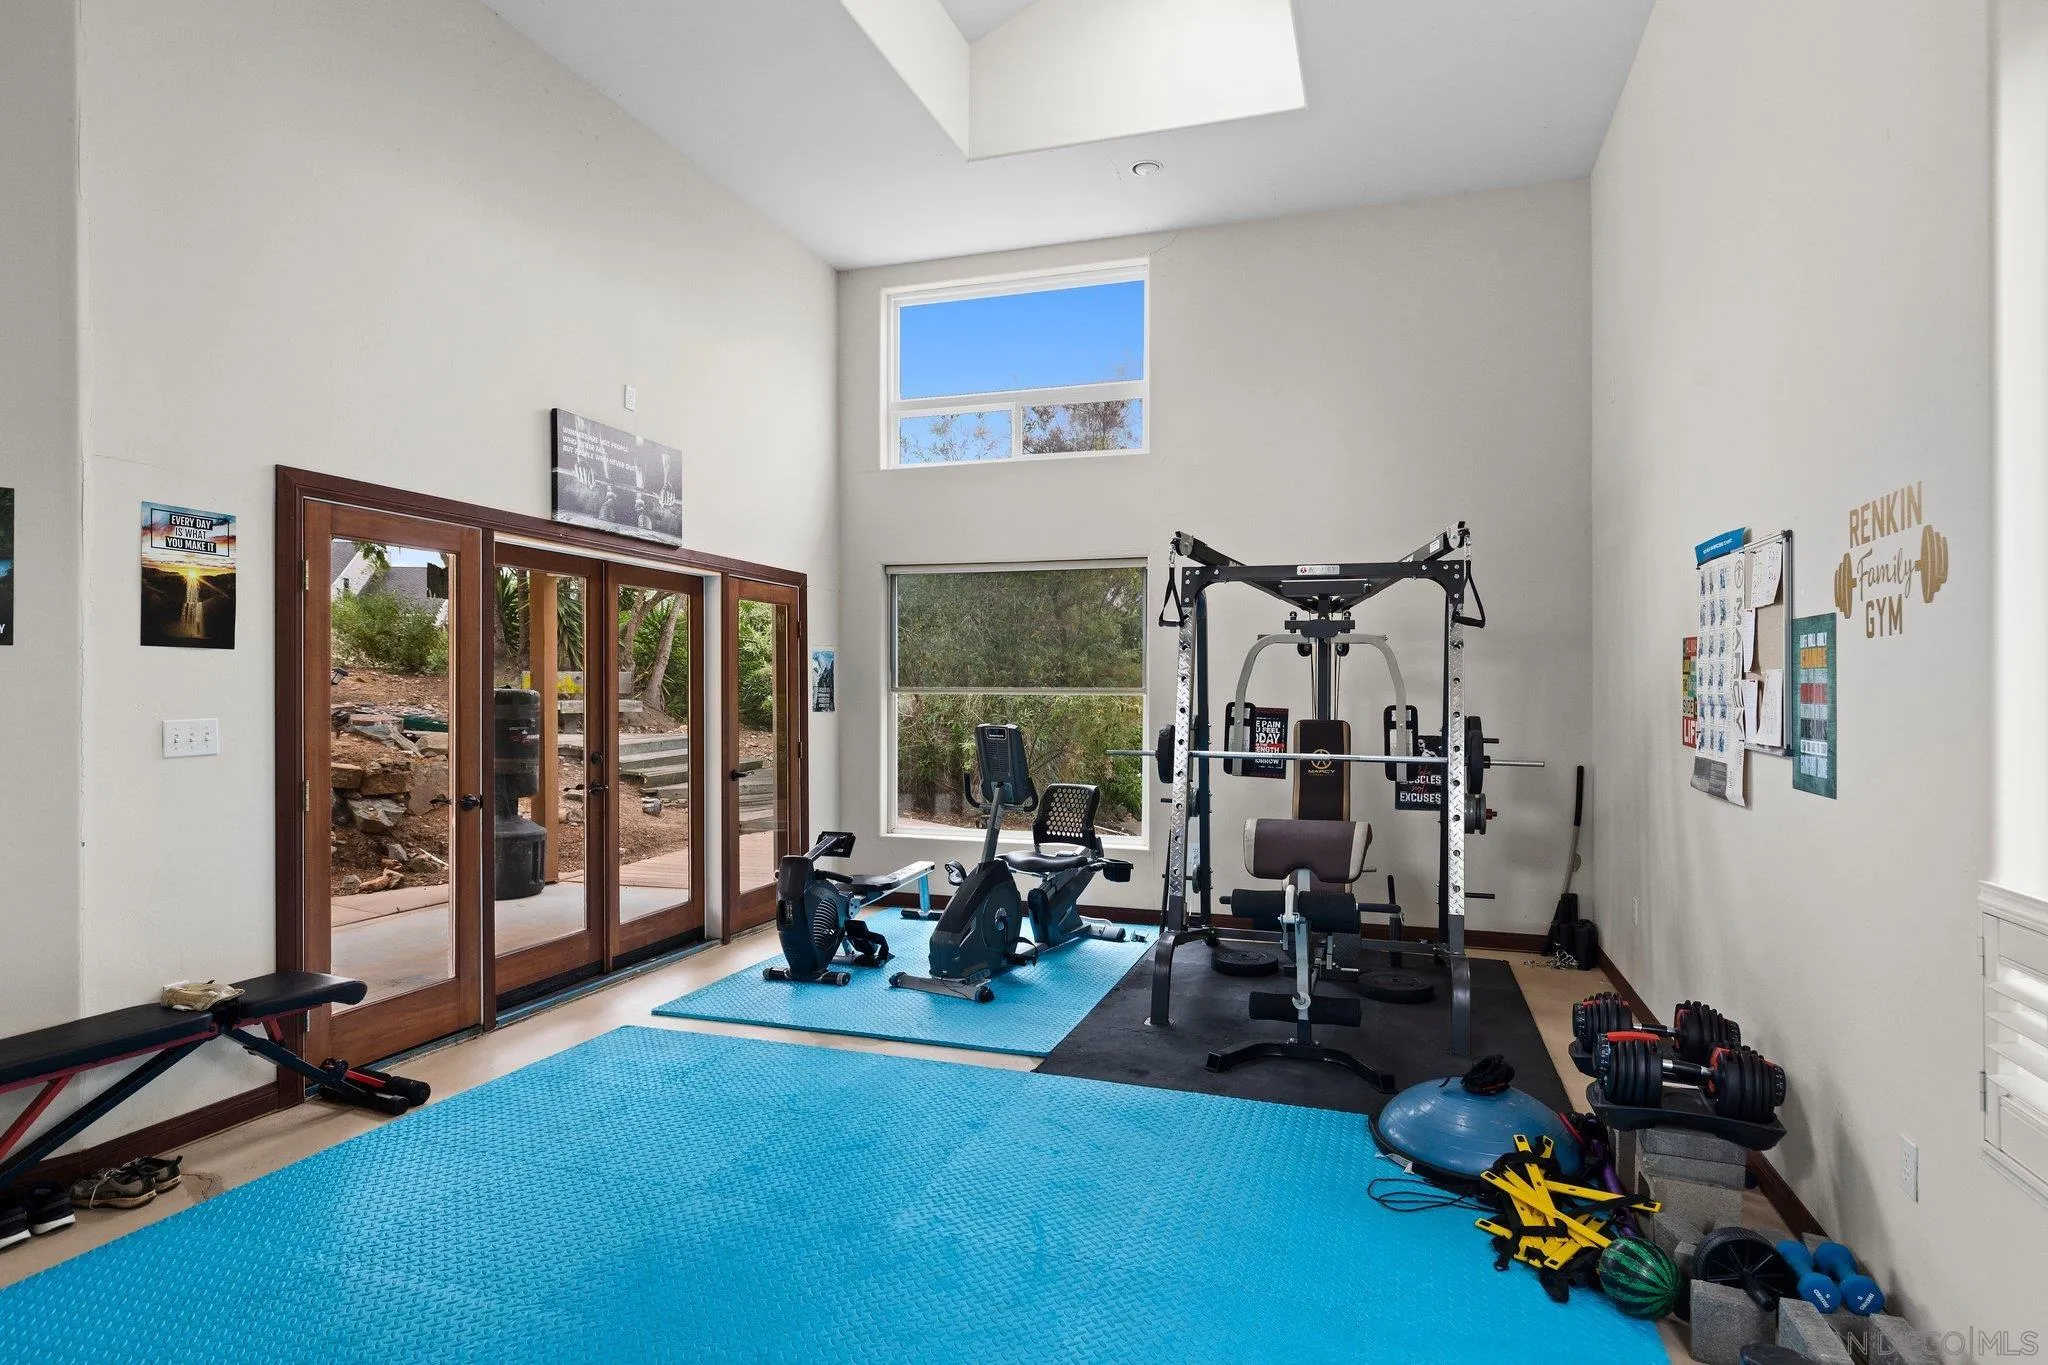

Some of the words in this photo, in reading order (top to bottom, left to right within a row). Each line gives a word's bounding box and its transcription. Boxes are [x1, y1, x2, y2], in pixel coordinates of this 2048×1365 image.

[562, 436, 577, 445] WHO
[562, 444, 574, 454] BUT
[1848, 480, 1922, 549] RENKIN
[171, 516, 194, 527] EVERY
[196, 519, 211, 529] DAY
[175, 526, 183, 537] IS
[184, 528, 207, 540] WHAT
[167, 538, 183, 548] YOU
[185, 540, 206, 551] MAKE
[207, 543, 214, 552] IT
[1856, 547, 1916, 602] Family
[1865, 593, 1903, 639] GYM
[1261, 720, 1281, 728] PAIN
[1684, 717, 1696, 744] LIF
[1255, 733, 1281, 745] DAY
[1399, 791, 1442, 804] EXCUSES
